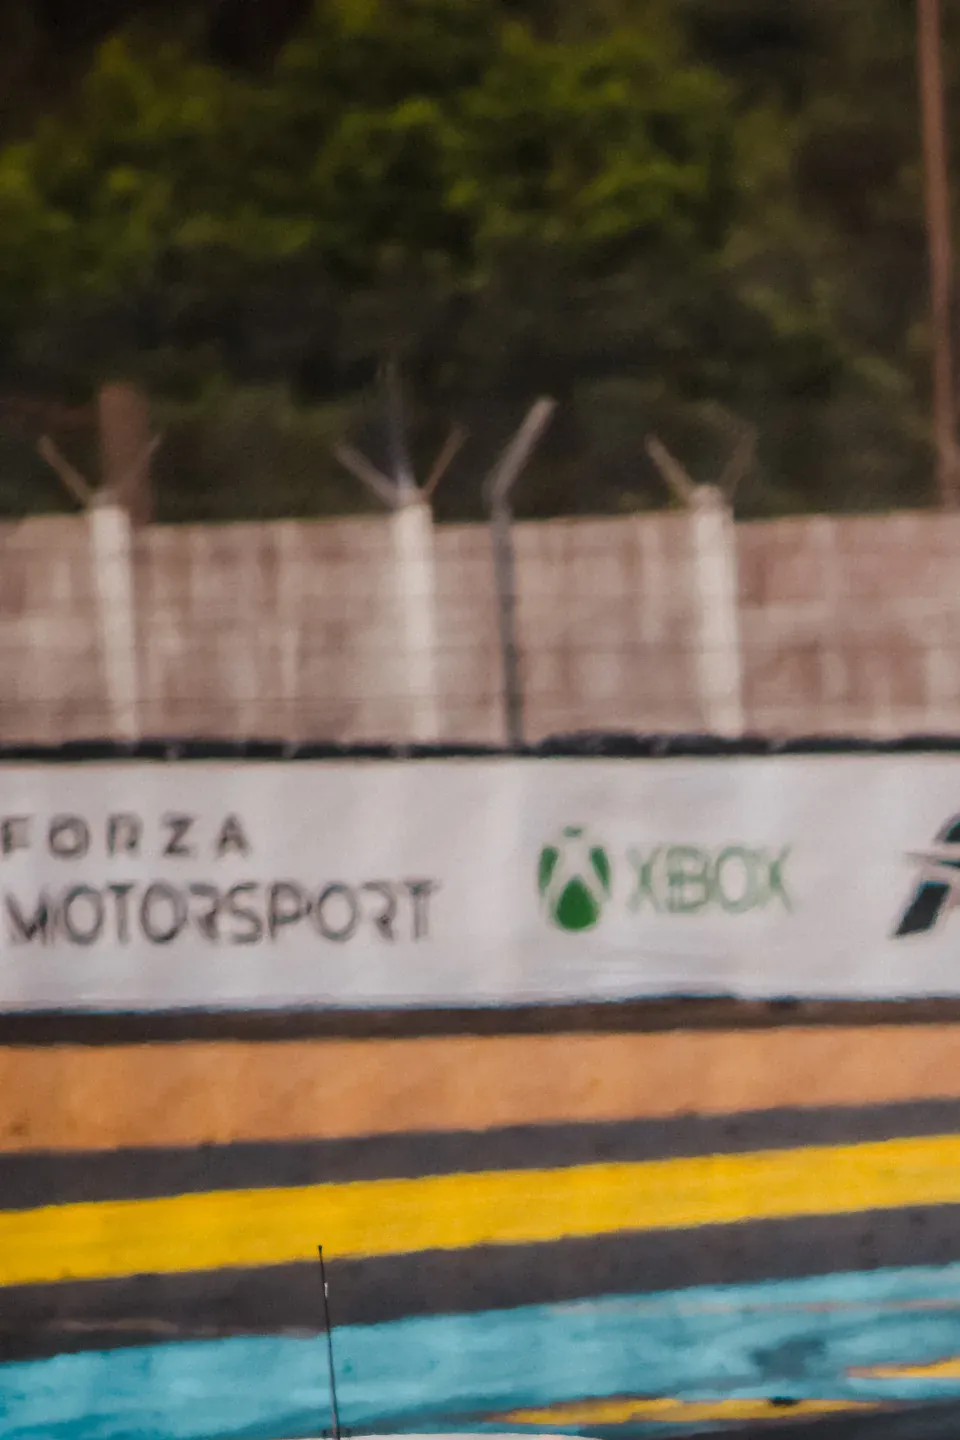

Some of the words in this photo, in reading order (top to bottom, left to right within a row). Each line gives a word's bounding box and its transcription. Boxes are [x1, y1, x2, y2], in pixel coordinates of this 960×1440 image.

[1, 813, 248, 858] FORZA
[4, 878, 438, 945] MOTORSPORT
[626, 843, 794, 915] XBOX
